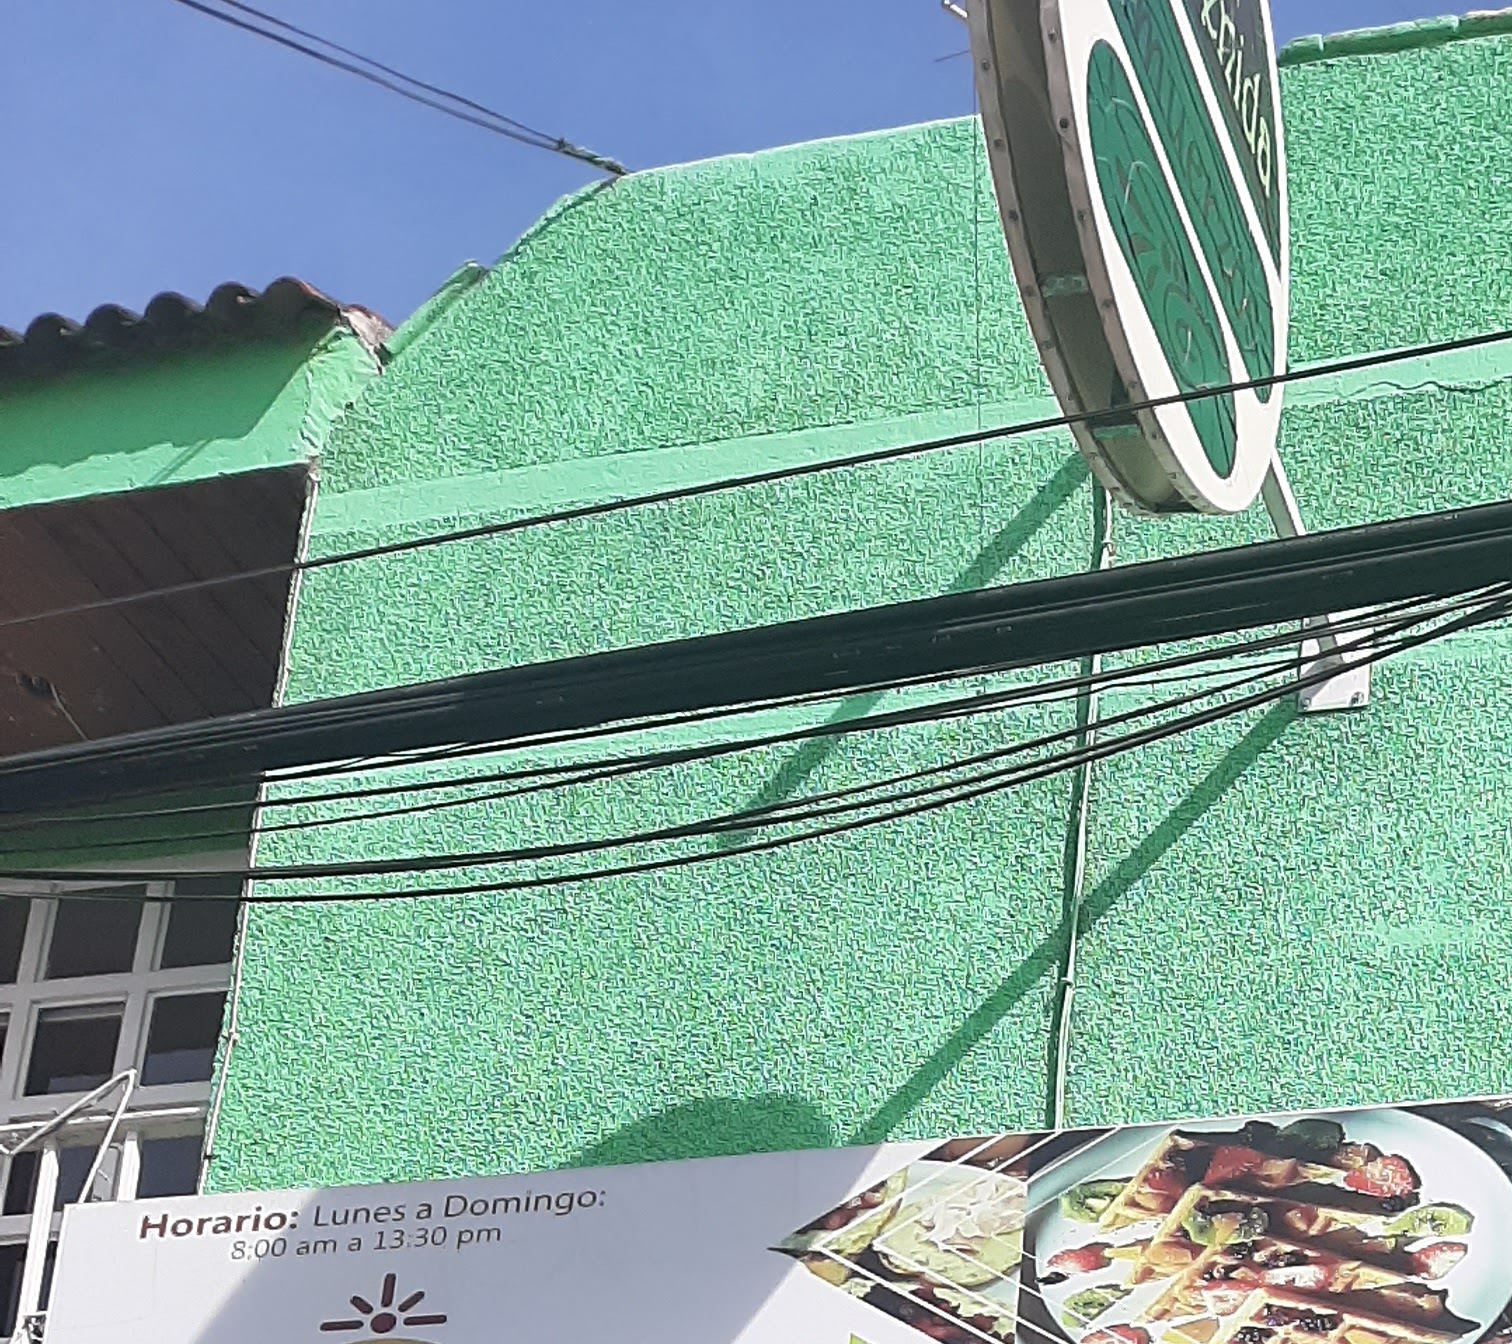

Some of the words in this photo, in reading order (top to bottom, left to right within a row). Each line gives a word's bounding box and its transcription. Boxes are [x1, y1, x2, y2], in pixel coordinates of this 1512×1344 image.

[138, 1206, 300, 1240] Horario:
[313, 1205, 406, 1228] Lunes
[415, 1204, 433, 1221] a
[443, 1189, 606, 1219] Domingo:
[230, 1238, 288, 1261] 8:00
[295, 1239, 338, 1257] am
[347, 1236, 362, 1253] a
[373, 1226, 448, 1250] 13:30
[456, 1227, 501, 1249] pm
